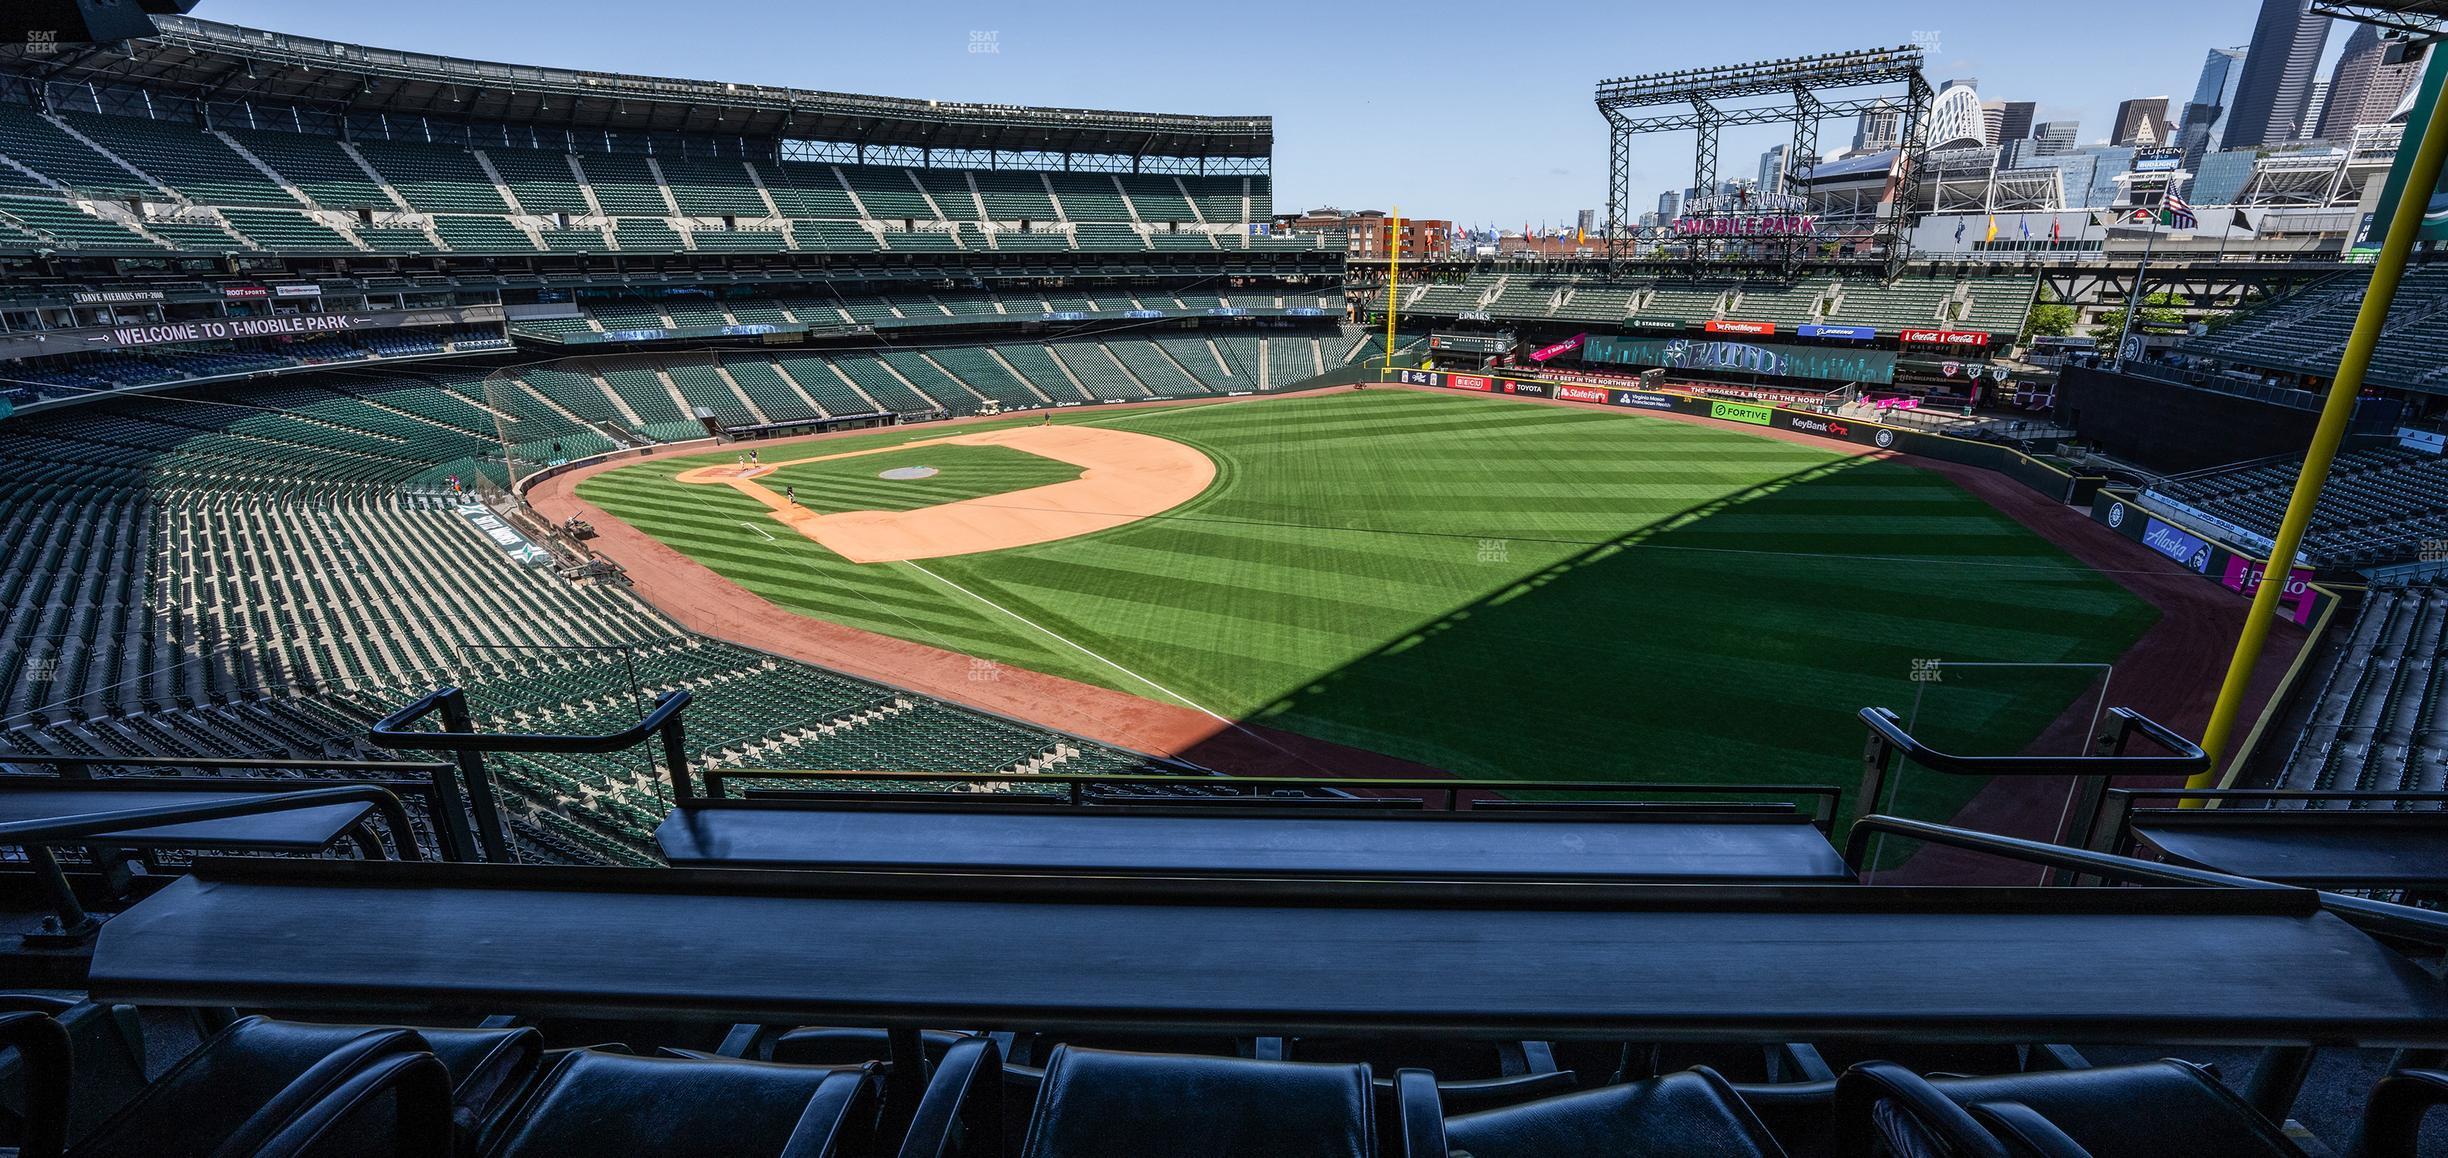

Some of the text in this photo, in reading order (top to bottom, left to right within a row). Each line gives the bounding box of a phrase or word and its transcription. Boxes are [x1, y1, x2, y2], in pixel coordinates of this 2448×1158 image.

[2140, 148, 2182, 156] LUMEN
[1672, 215, 1819, 235] T-MOBILE PARK
[82, 293, 101, 303] DAVE
[102, 292, 134, 302] NIEHAUS
[114, 315, 350, 345] WELCOME TO T-MOBILE PARK
[1457, 378, 1482, 387] BECU
[1516, 384, 1542, 392] TOYOTA
[1598, 378, 1640, 388] NORTHWEST
[1728, 408, 1767, 420] FORTIVE
[1792, 418, 1827, 432] KeyBank
[2147, 528, 2188, 558] Alaska
